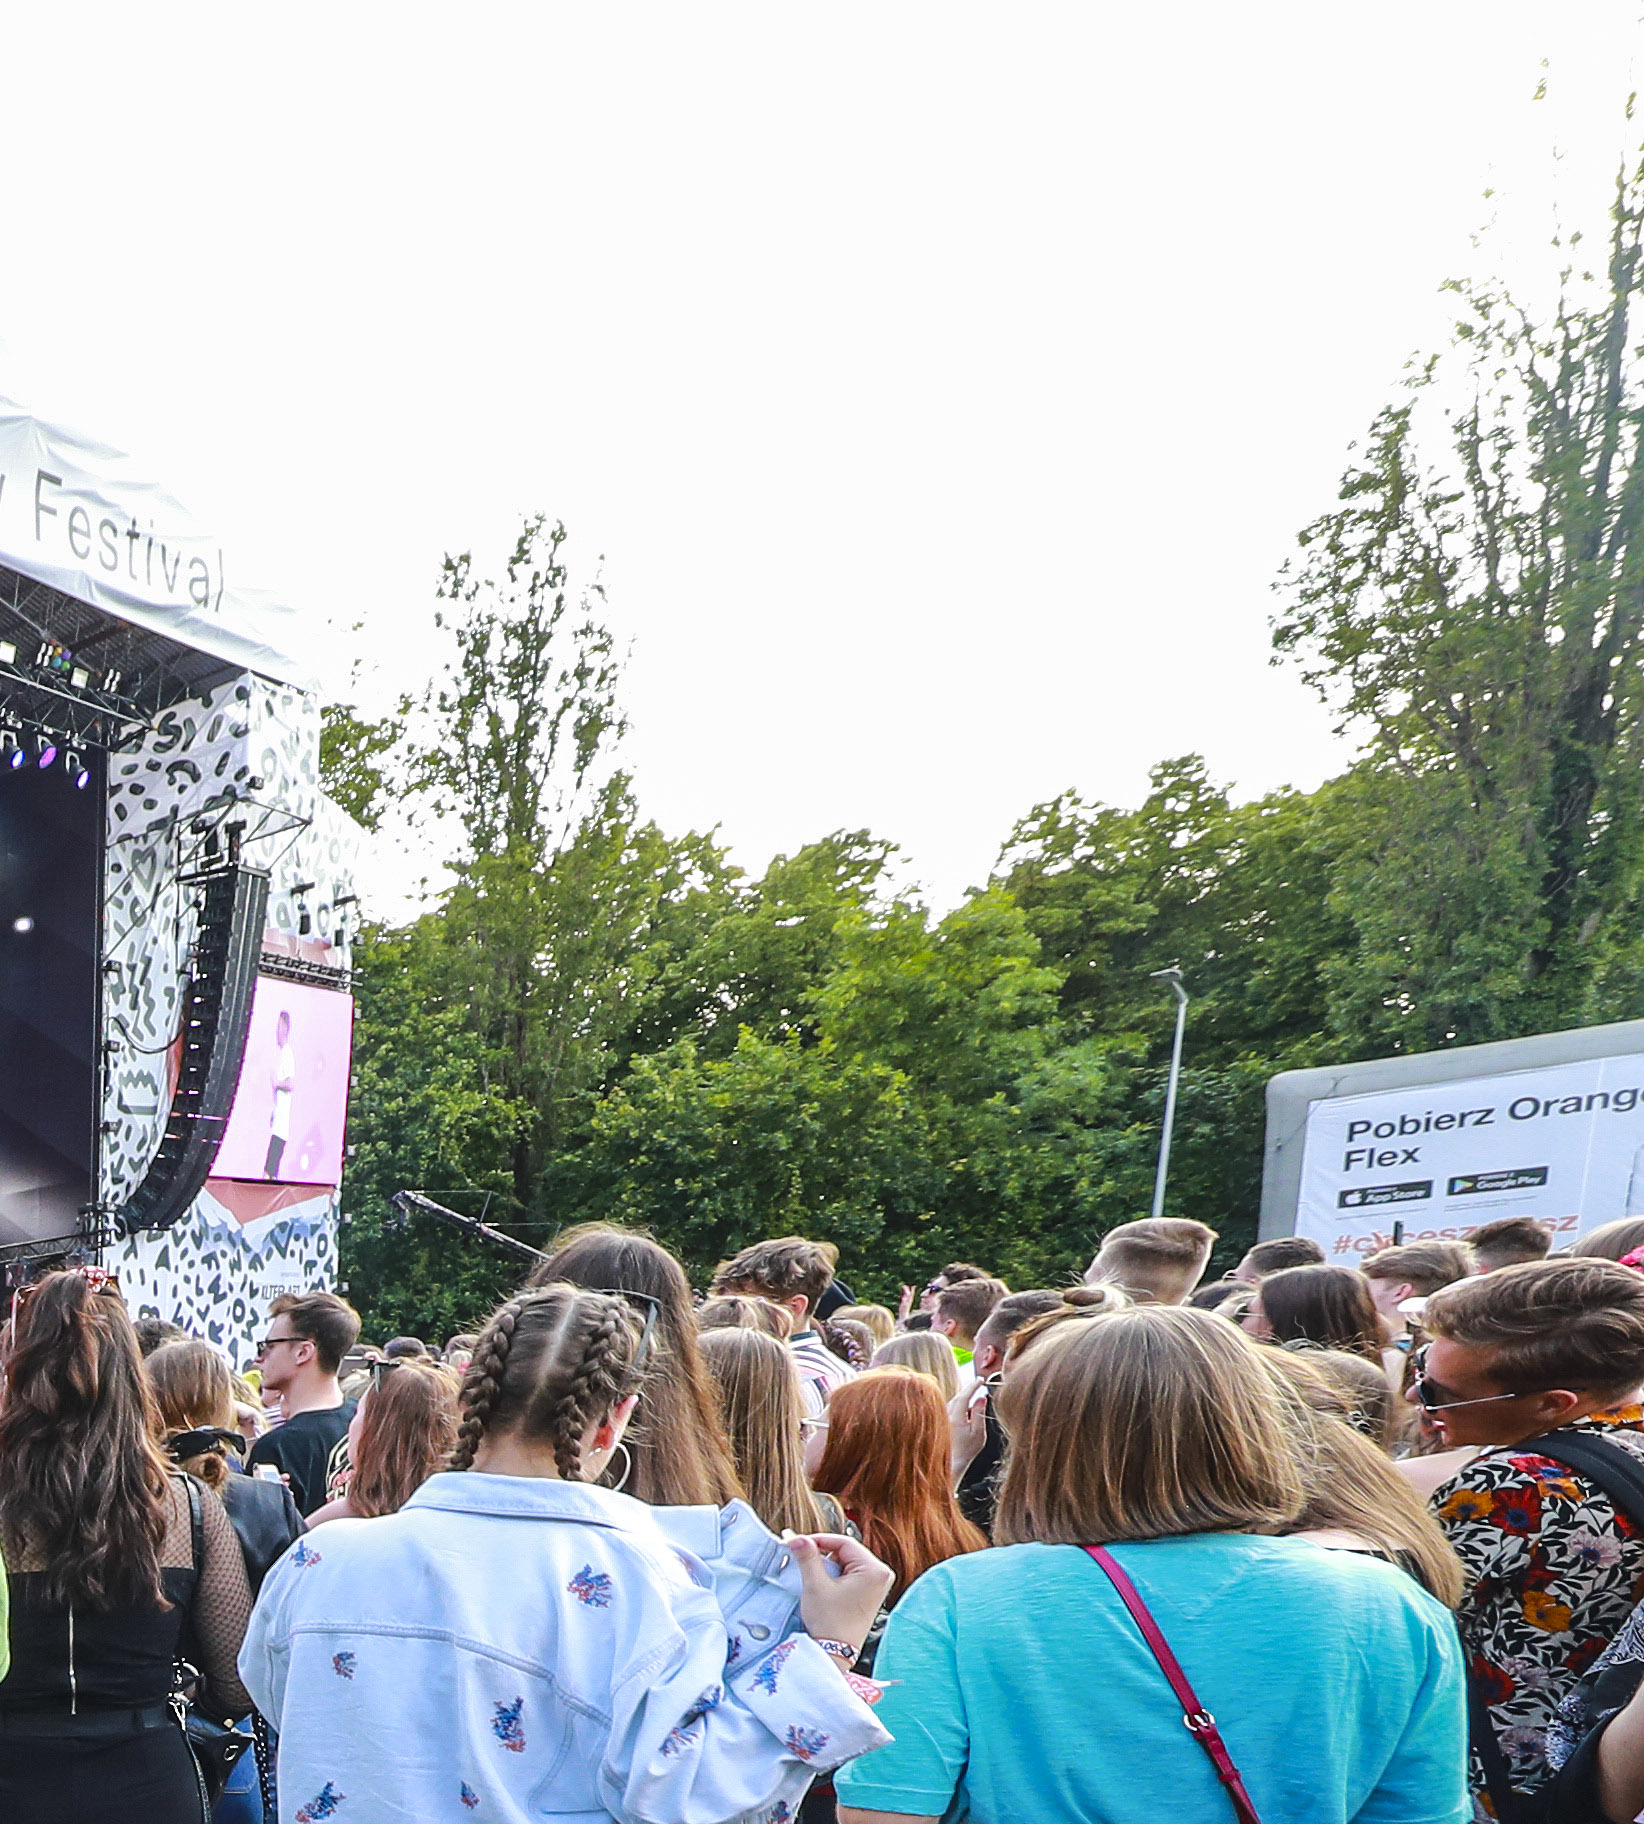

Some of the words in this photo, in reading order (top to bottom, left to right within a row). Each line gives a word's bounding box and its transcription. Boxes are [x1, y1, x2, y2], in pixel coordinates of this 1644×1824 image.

[33, 469, 225, 614] Festival
[1346, 1107, 1496, 1143] Pobierz
[1508, 1087, 1644, 1121] Orang
[1342, 1147, 1421, 1172] Flex
